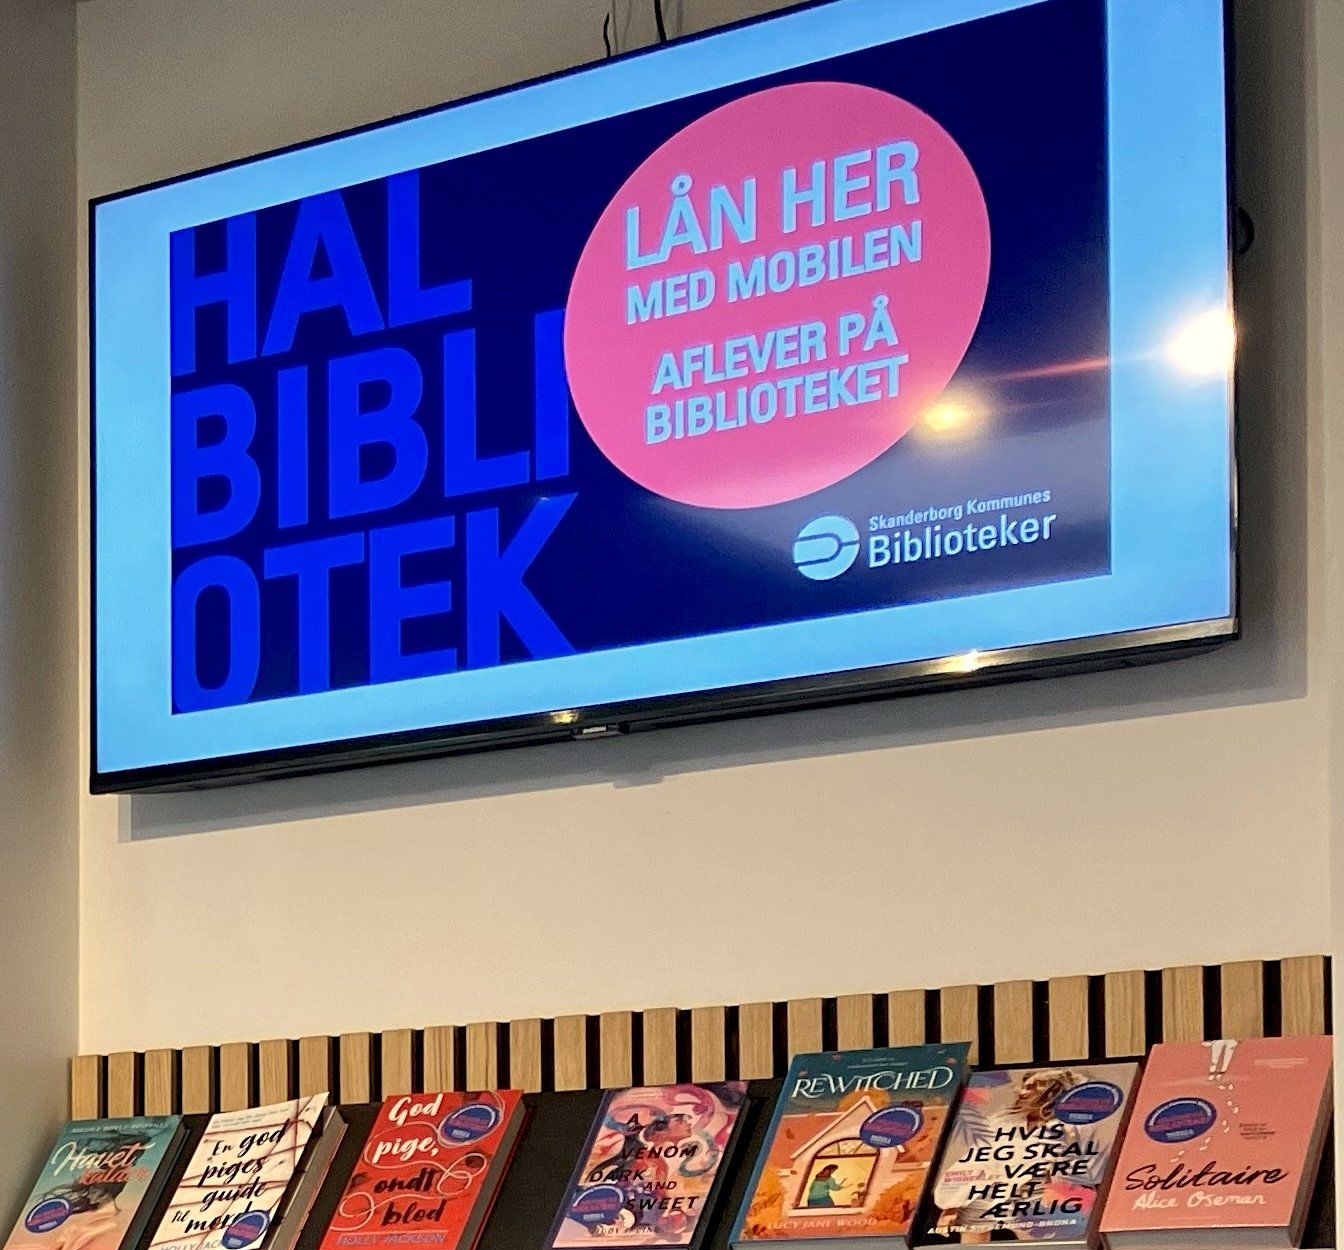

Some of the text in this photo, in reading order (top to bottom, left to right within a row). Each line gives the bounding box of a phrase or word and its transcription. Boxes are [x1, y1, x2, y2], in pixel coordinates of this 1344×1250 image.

[624, 139, 920, 270] LÅN HER
[170, 171, 472, 376] HAL
[626, 220, 922, 325] MED MOBILEN
[651, 295, 900, 395] AFLEVER PÅ
[645, 355, 909, 445] BIBLIOTEKET
[171, 308, 572, 549] BIBLI
[869, 489, 1051, 534] Skanderborg Kommunes
[868, 511, 1057, 569] Biblioteker
[173, 492, 579, 713] OTEK
[791, 1066, 954, 1098] REWITCHED
[388, 1093, 443, 1125] God
[626, 1113, 639, 1125] A
[212, 1118, 290, 1157] En god
[995, 1123, 1065, 1142] HVIS
[372, 1135, 440, 1164] pige,
[621, 1145, 698, 1159] VENOM
[959, 1140, 1099, 1163] JEG SKAL
[197, 1155, 270, 1188] piges
[374, 1168, 440, 1194] ondt
[589, 1169, 647, 1182] DARK
[1004, 1159, 1090, 1179] VÆRE
[1125, 1160, 1289, 1192] Solitaire
[643, 1181, 677, 1190] AND
[968, 1181, 1042, 1200] HELT
[1131, 1189, 1267, 1211] Alice Oseman
[382, 1200, 443, 1228] blod
[625, 1196, 699, 1210] SWEET
[979, 1197, 1083, 1219] ÆRLIG
